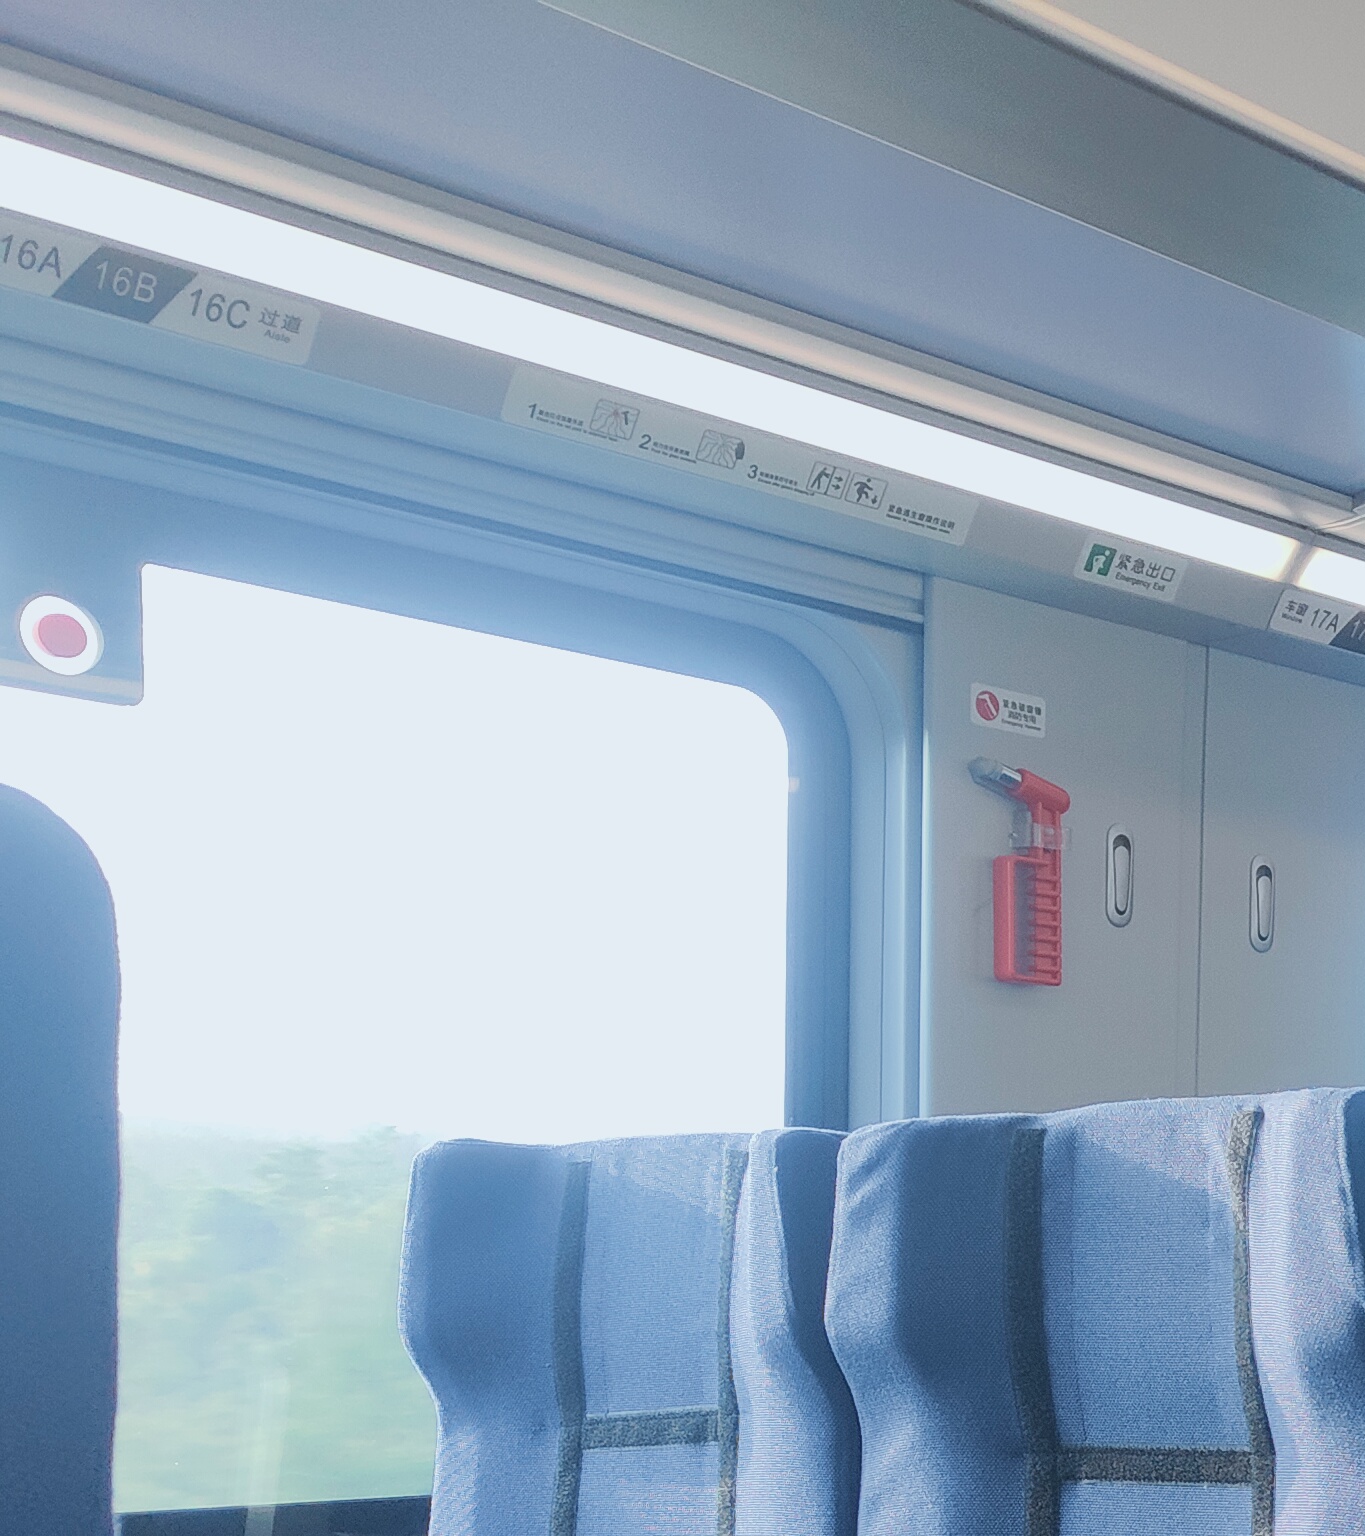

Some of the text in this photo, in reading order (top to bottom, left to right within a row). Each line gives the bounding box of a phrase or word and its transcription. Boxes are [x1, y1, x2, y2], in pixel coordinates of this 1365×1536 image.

[1, 234, 302, 334] 16A 16B 16C 过道
[264, 329, 291, 343] Aisle
[638, 434, 651, 450] 2
[747, 464, 758, 479] 3
[1115, 553, 1176, 582] 紧急出口
[1115, 572, 1166, 592] Emergency Exit
[1310, 608, 1340, 633] 17A
